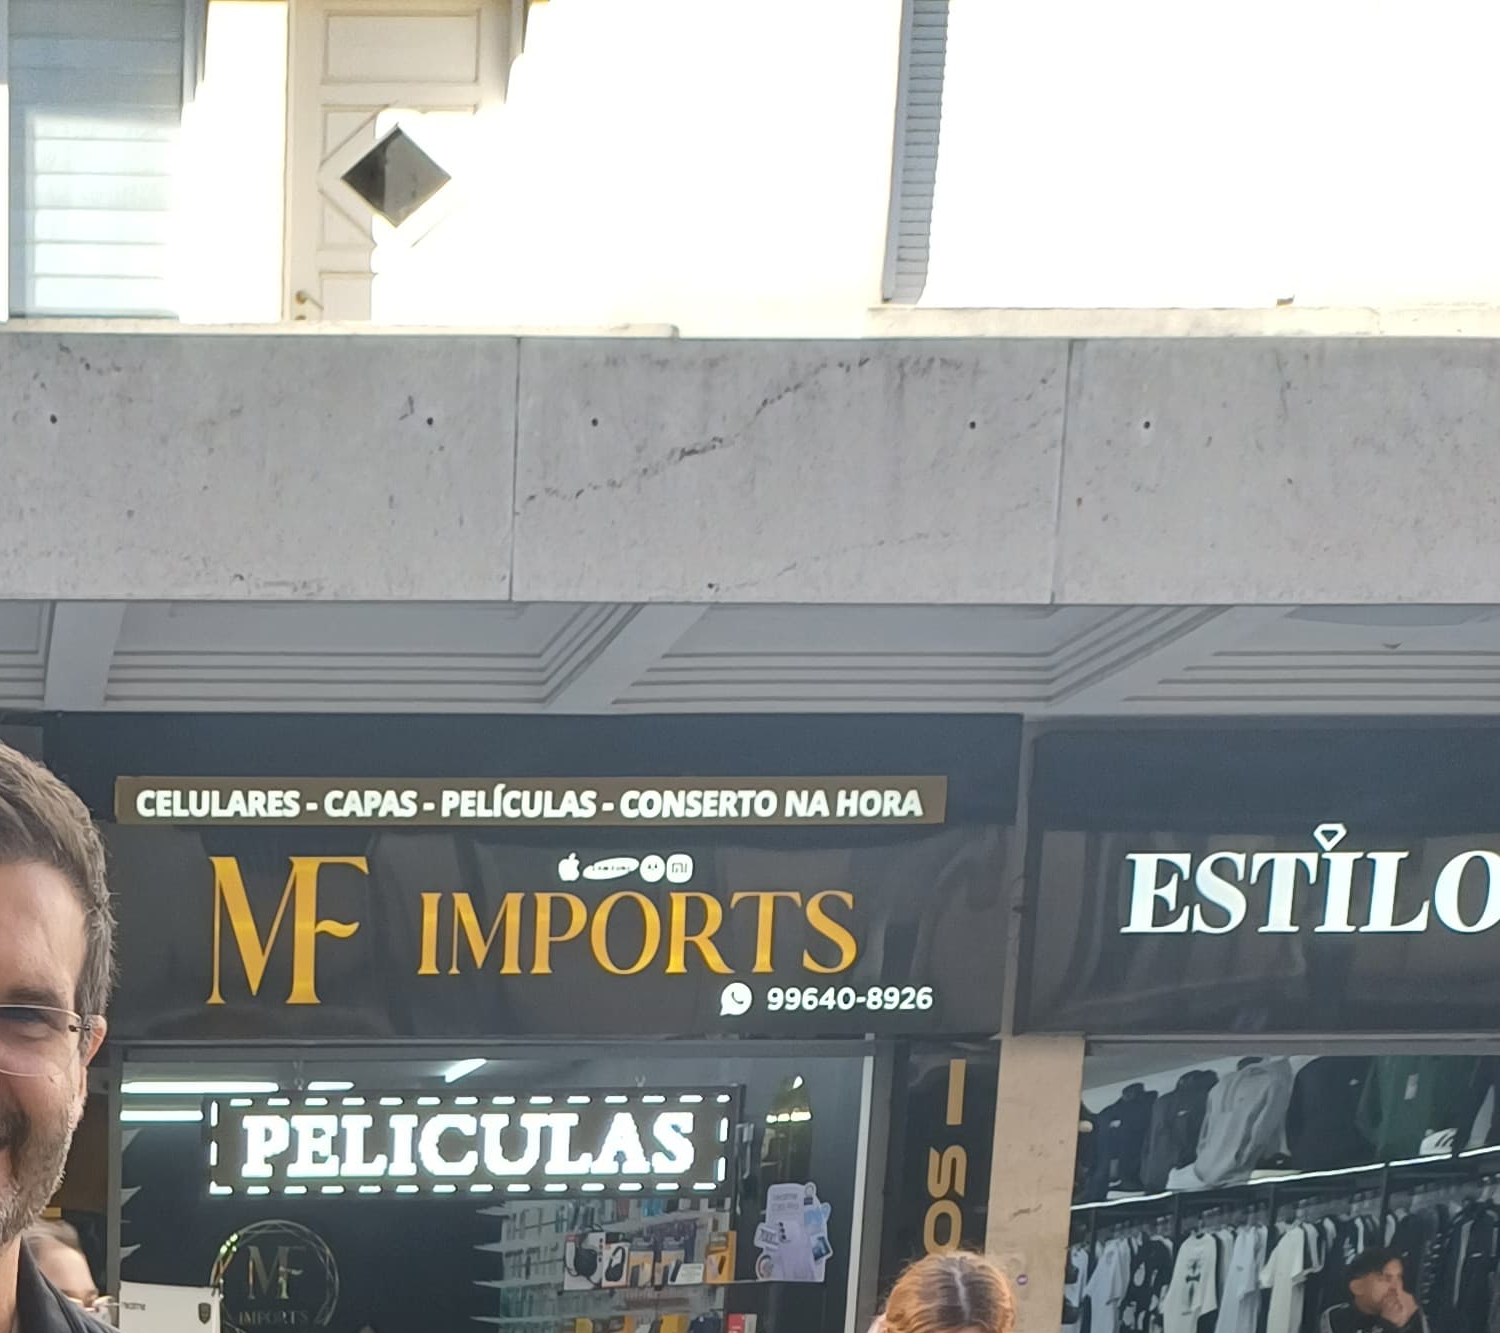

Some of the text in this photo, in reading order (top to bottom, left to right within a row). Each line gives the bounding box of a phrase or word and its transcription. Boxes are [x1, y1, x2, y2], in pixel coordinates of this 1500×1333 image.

[136, 789, 301, 818] CELULARES
[323, 790, 418, 818] CAPAS
[441, 783, 597, 818] PELÍCULAS
[619, 789, 778, 819] CONSERTO
[784, 789, 830, 818] NA
[835, 789, 924, 818] HORA
[1119, 824, 1500, 934] ESTILO
[206, 855, 369, 1005] MF
[419, 890, 857, 976] IMPORTS
[767, 986, 933, 1011] 99640-8926
[241, 1111, 695, 1178] PELICULAS
